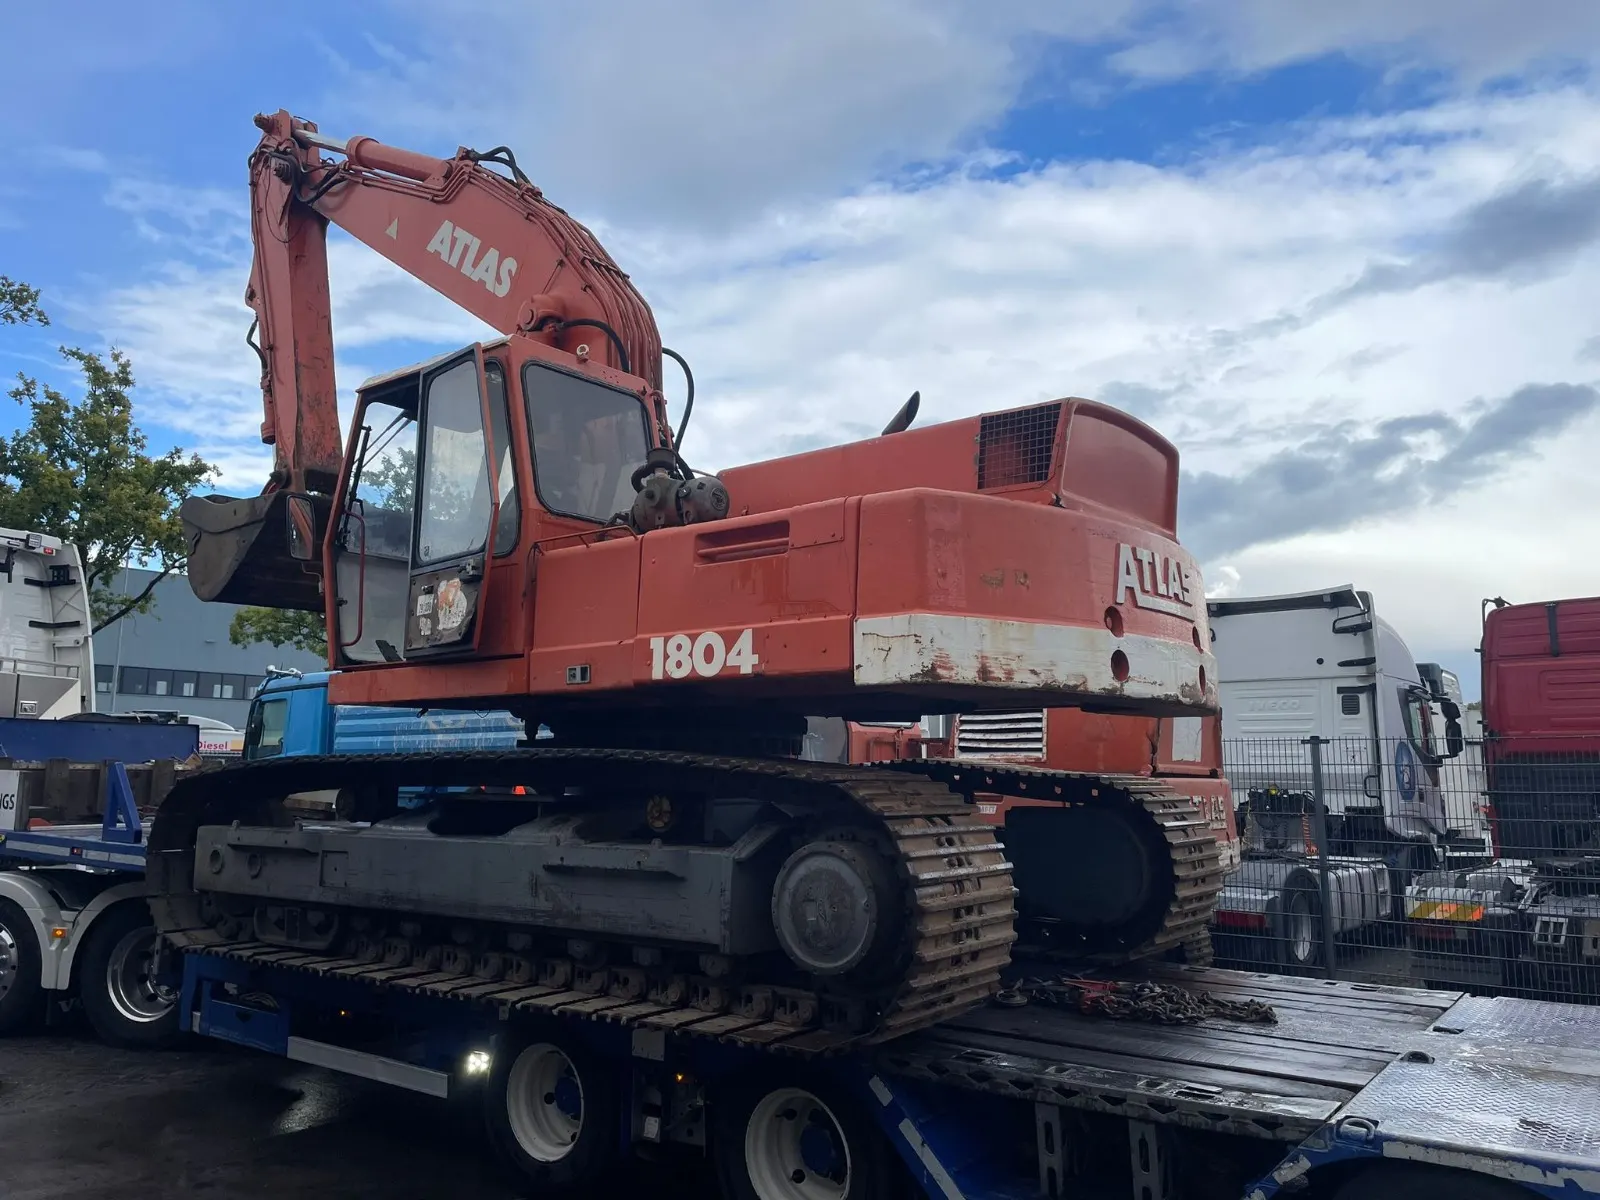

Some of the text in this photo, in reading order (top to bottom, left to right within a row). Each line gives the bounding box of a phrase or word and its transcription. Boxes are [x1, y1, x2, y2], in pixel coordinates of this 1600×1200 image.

[426, 220, 518, 298] ATLAS
[1115, 542, 1194, 612] ATLAS
[649, 628, 759, 681] 1804
